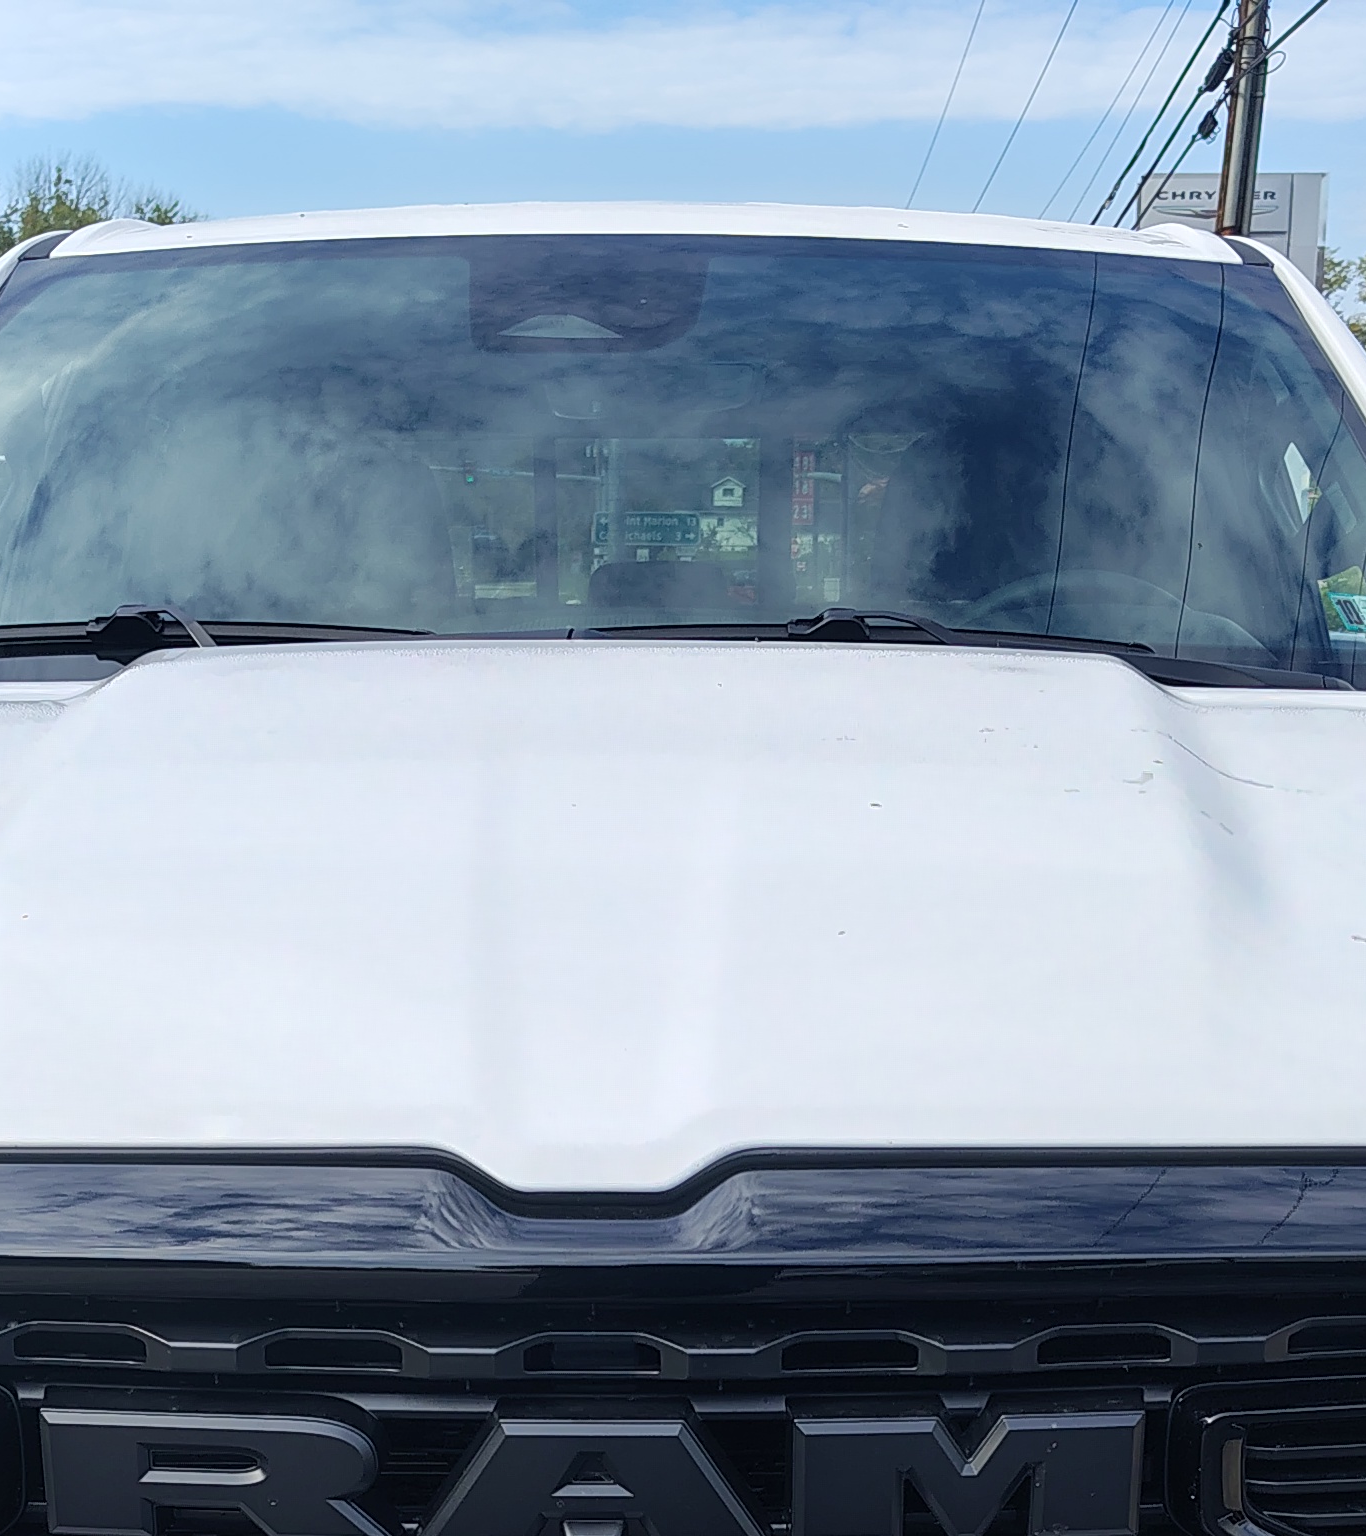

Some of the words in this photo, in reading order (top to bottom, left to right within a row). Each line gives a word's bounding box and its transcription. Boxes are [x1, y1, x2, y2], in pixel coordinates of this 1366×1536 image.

[1157, 190, 1277, 201] CHRYER
[644, 517, 679, 526] Marion
[599, 531, 663, 541] Cichaels
[1336, 599, 1365, 625] 10
